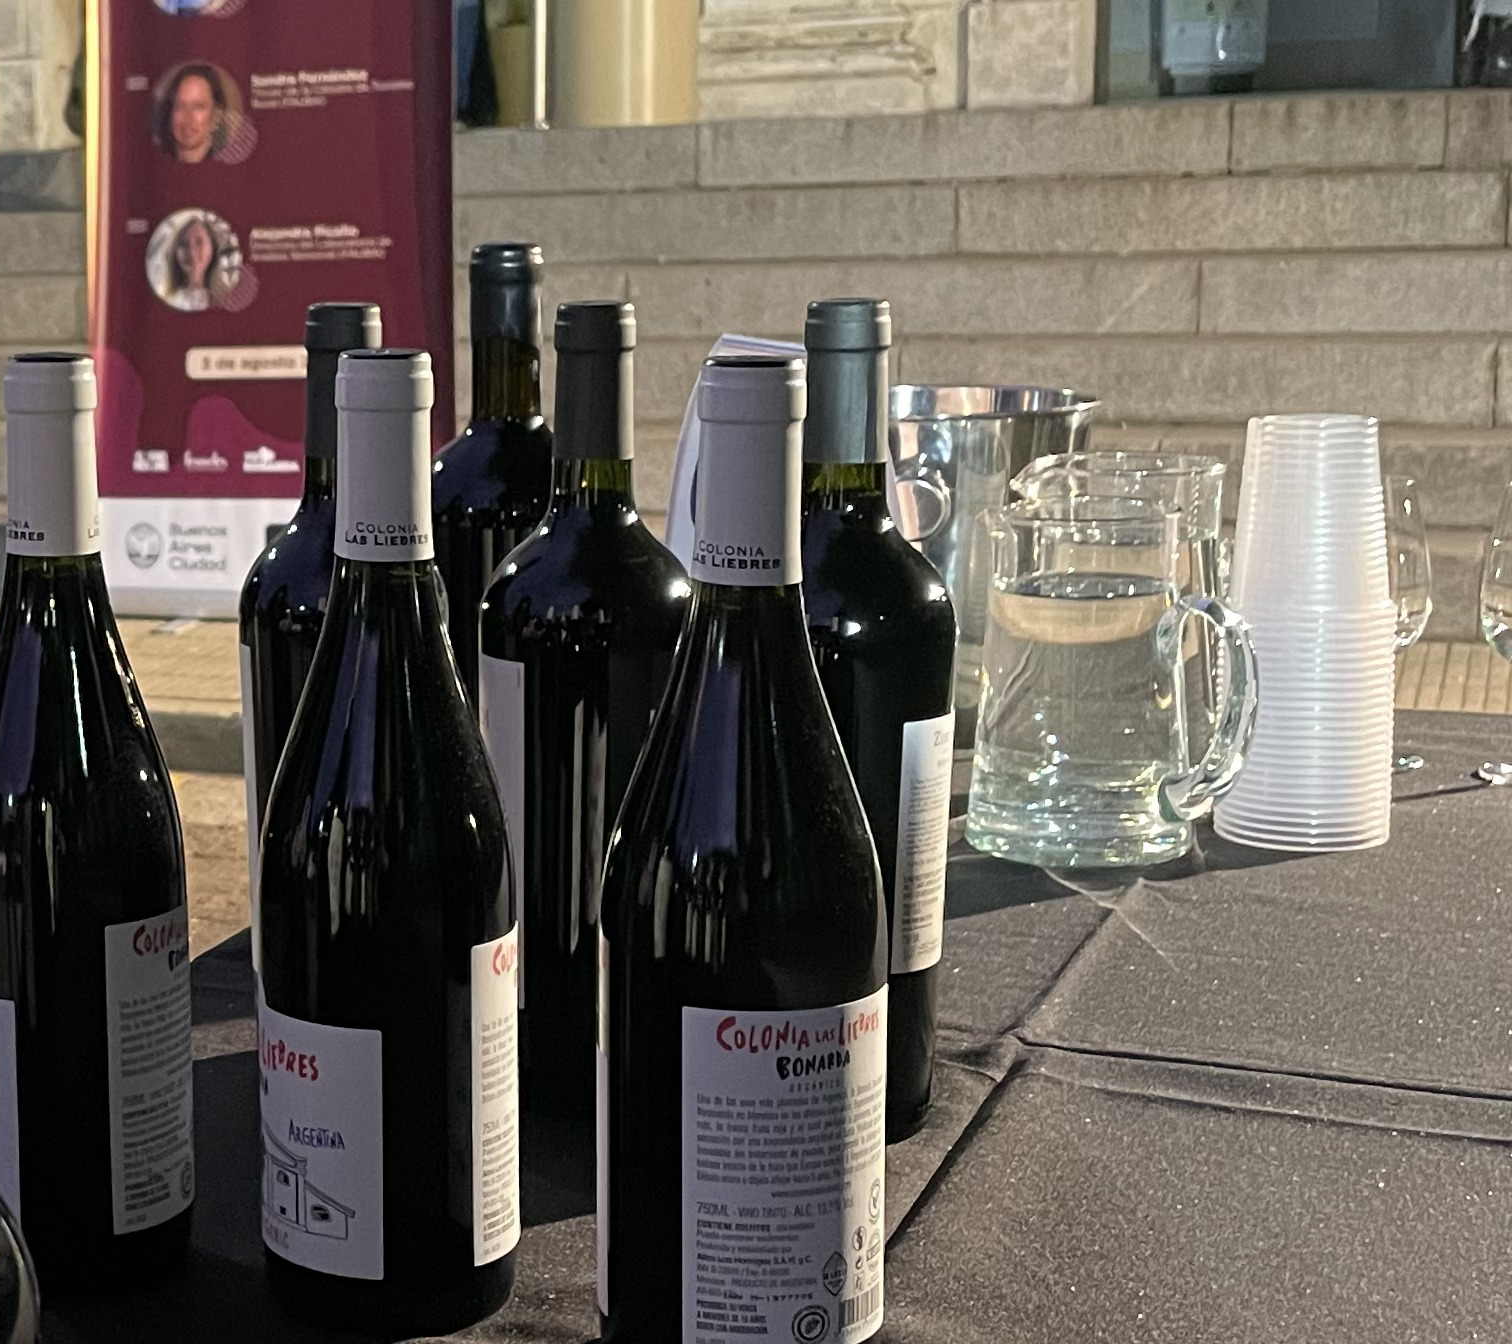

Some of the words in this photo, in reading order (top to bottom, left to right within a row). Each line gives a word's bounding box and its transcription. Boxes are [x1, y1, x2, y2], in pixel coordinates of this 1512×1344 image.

[169, 522, 227, 537] Buenos
[356, 521, 419, 534] COLONIA
[345, 531, 368, 545] LAS
[374, 534, 428, 546] LIEBRES
[169, 540, 212, 553] Aires
[699, 540, 764, 557] COLONIA
[169, 557, 228, 571] Ciudad
[712, 555, 781, 569] LIEBRES
[716, 1015, 810, 1053] COLONIA
[815, 1028, 835, 1043] LAS
[839, 1009, 879, 1046] LIEBRES
[776, 1050, 850, 1080] BONARDA
[288, 1118, 345, 1150] ARGENTINA
